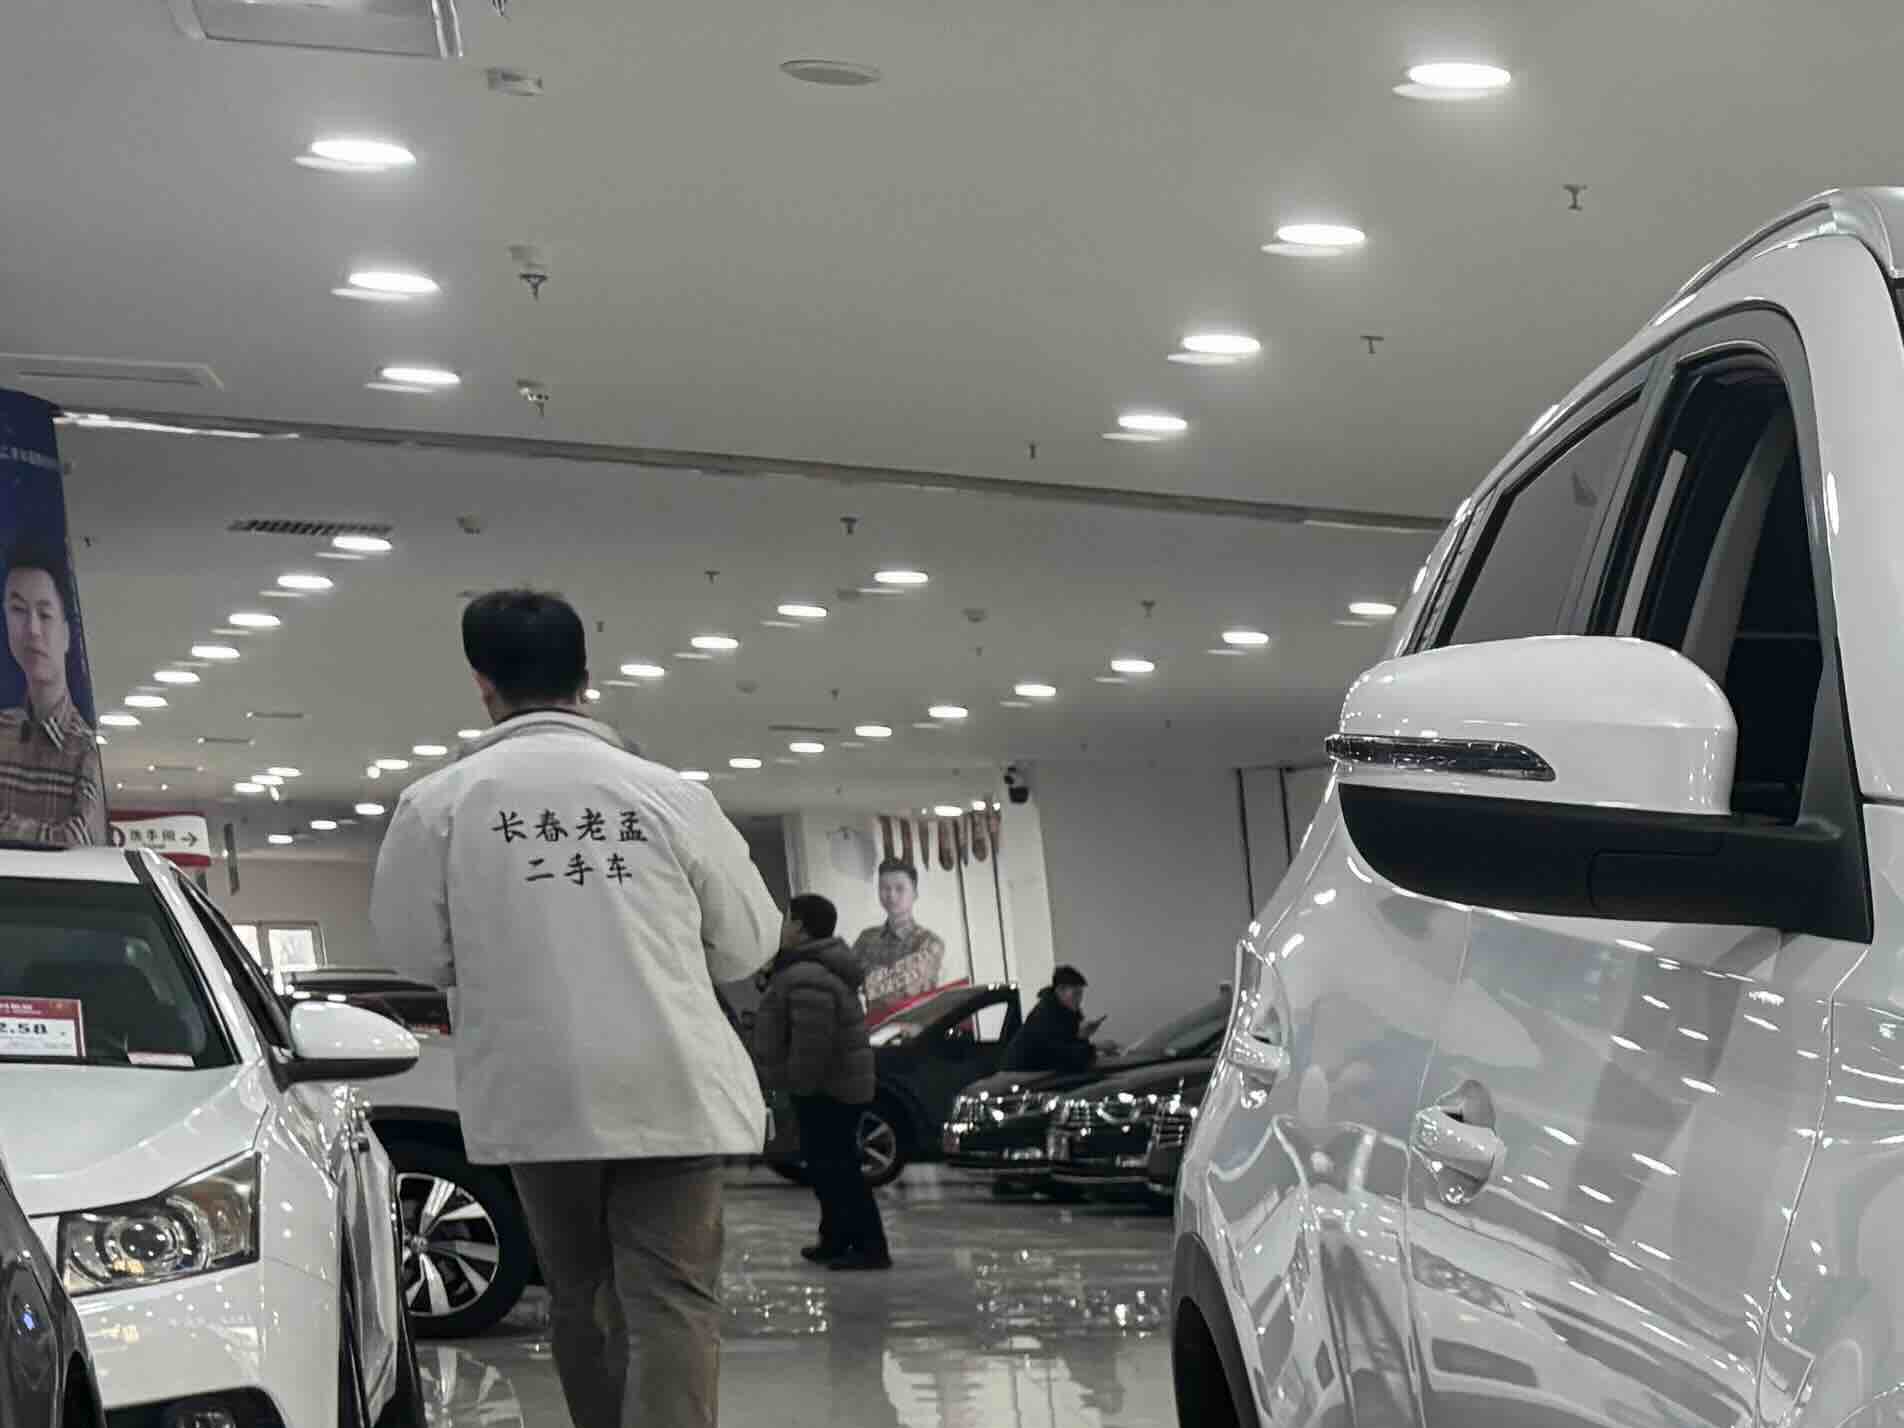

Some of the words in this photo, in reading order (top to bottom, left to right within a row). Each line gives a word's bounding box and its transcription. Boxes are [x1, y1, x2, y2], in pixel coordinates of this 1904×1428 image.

[492, 808, 648, 843] 长春老孟
[525, 852, 632, 886] 二手车
